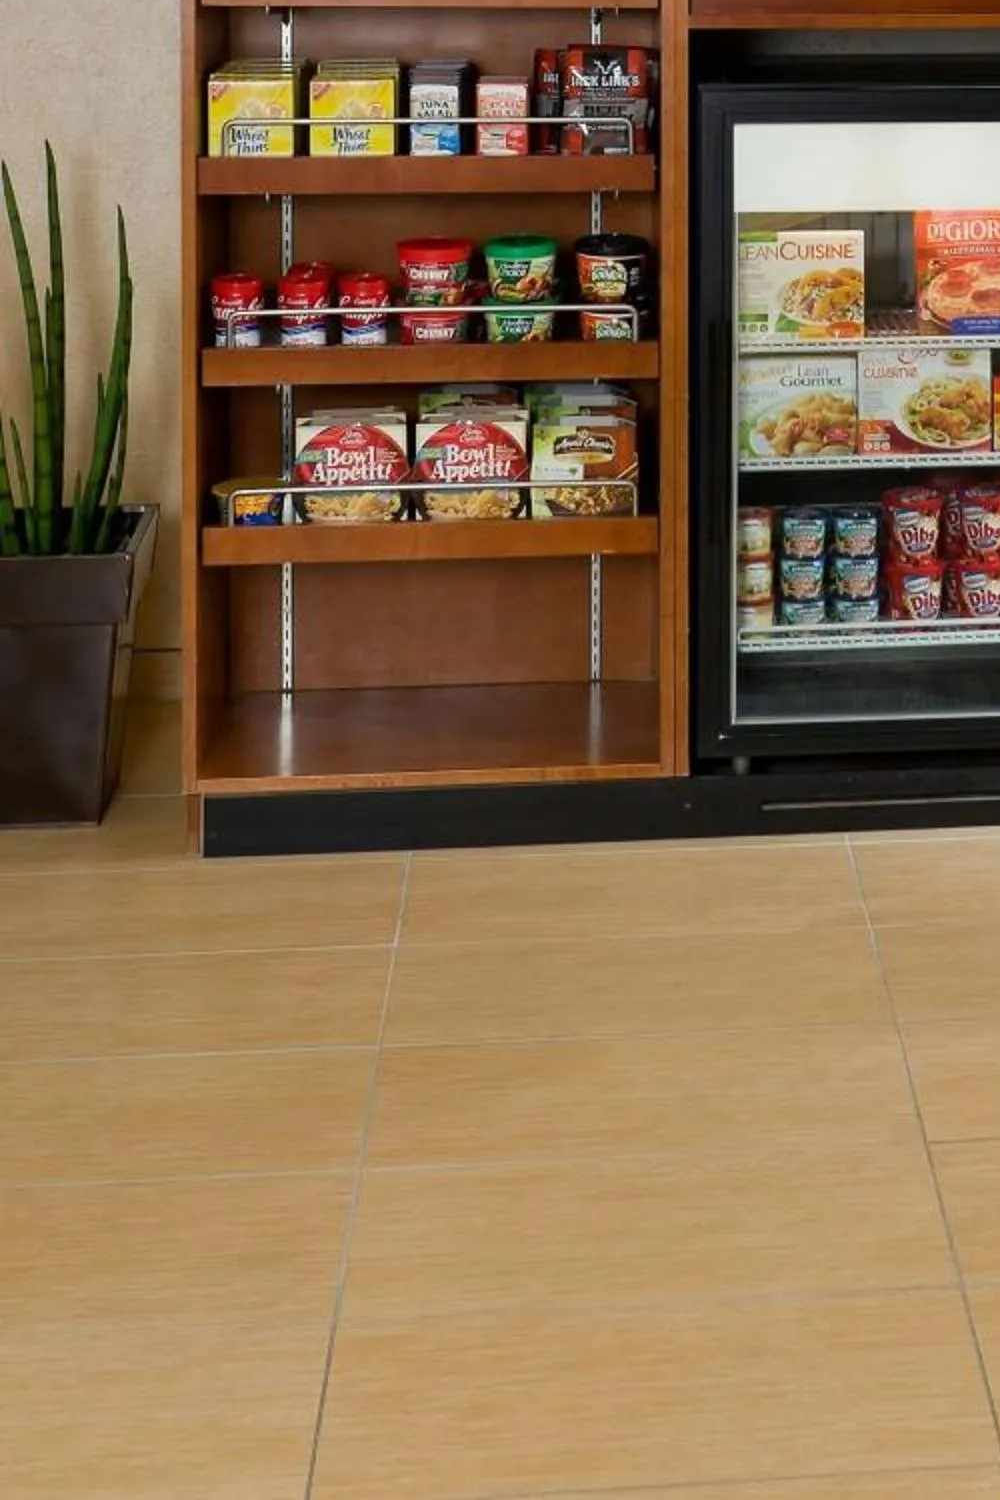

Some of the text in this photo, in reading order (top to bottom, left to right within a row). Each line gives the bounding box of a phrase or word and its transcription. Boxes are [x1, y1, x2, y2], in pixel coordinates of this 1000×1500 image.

[420, 101, 449, 110] TUNA
[780, 376, 843, 388] Gourmet
[326, 446, 375, 466] Bowl
[445, 443, 496, 465] Bowl
[901, 529, 935, 543] Dibs
